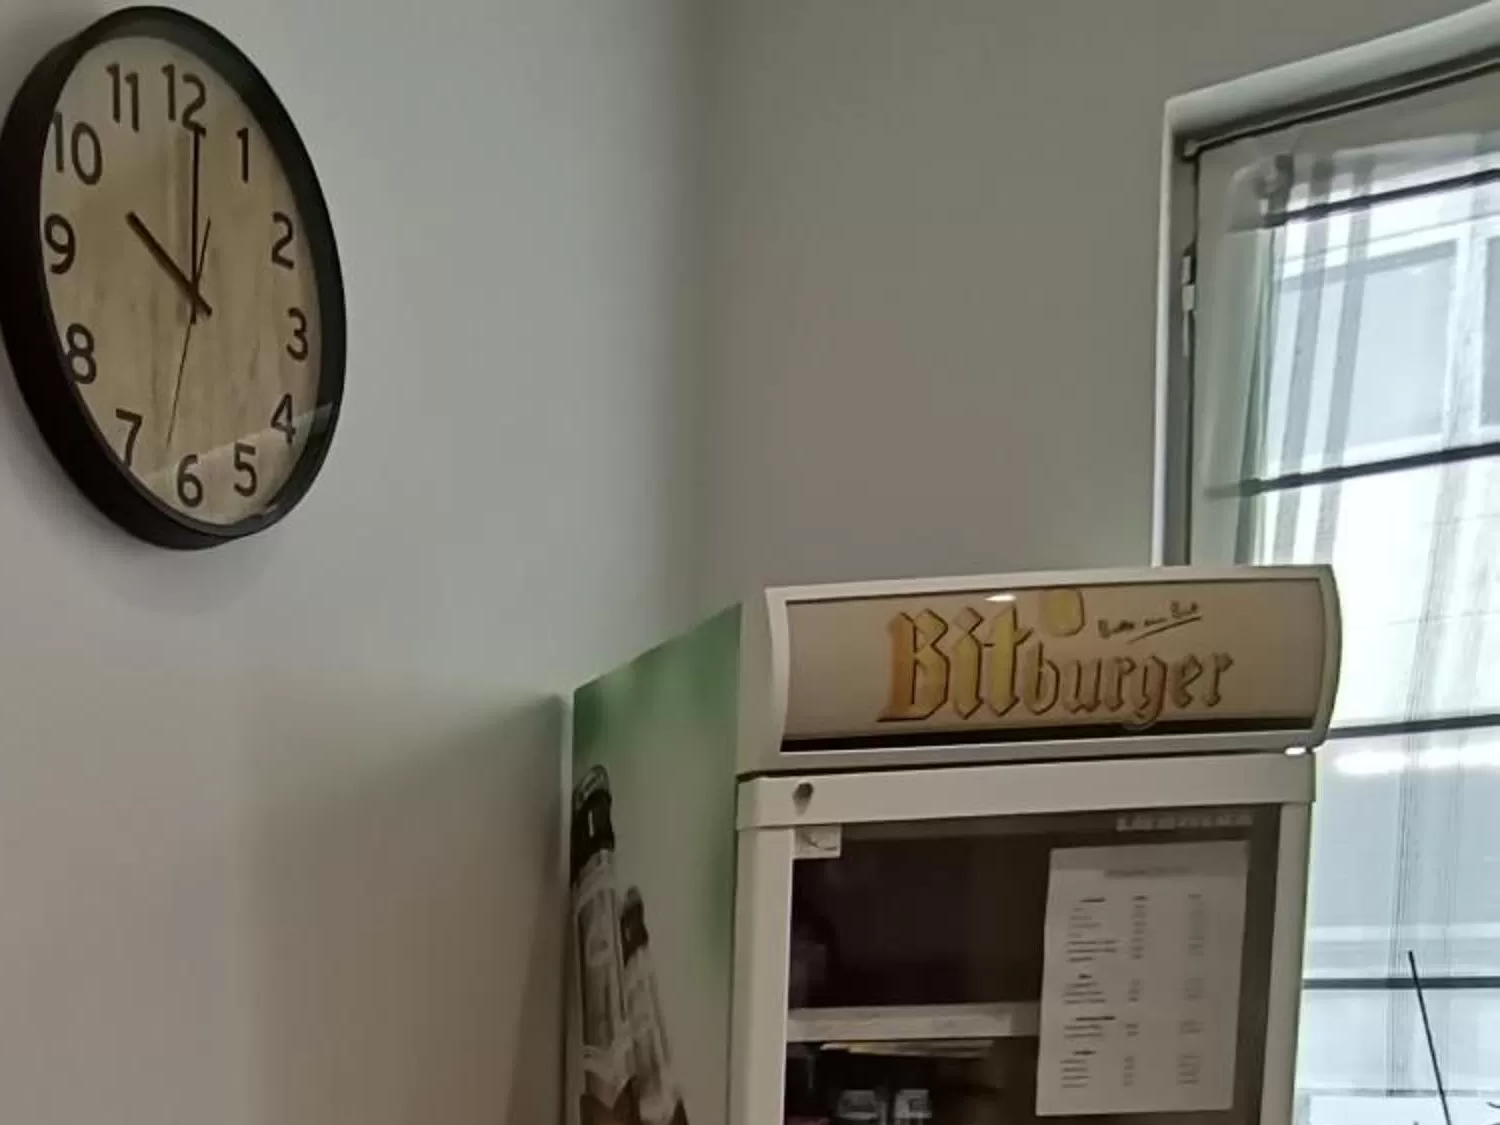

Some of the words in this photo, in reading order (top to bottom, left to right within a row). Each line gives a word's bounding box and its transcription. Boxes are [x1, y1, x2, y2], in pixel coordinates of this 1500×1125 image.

[105, 63, 140, 132] 11
[161, 63, 207, 138] 12
[51, 111, 103, 186] 10
[236, 127, 250, 184] 1
[43, 213, 76, 275] 9
[271, 211, 295, 270] 2
[64, 323, 98, 386] 8
[285, 307, 309, 362] 3
[115, 408, 143, 468] 7
[270, 392, 296, 445] 4
[176, 454, 204, 508] 6
[234, 443, 259, 499] 5
[877, 606, 1235, 725] Bitburger
